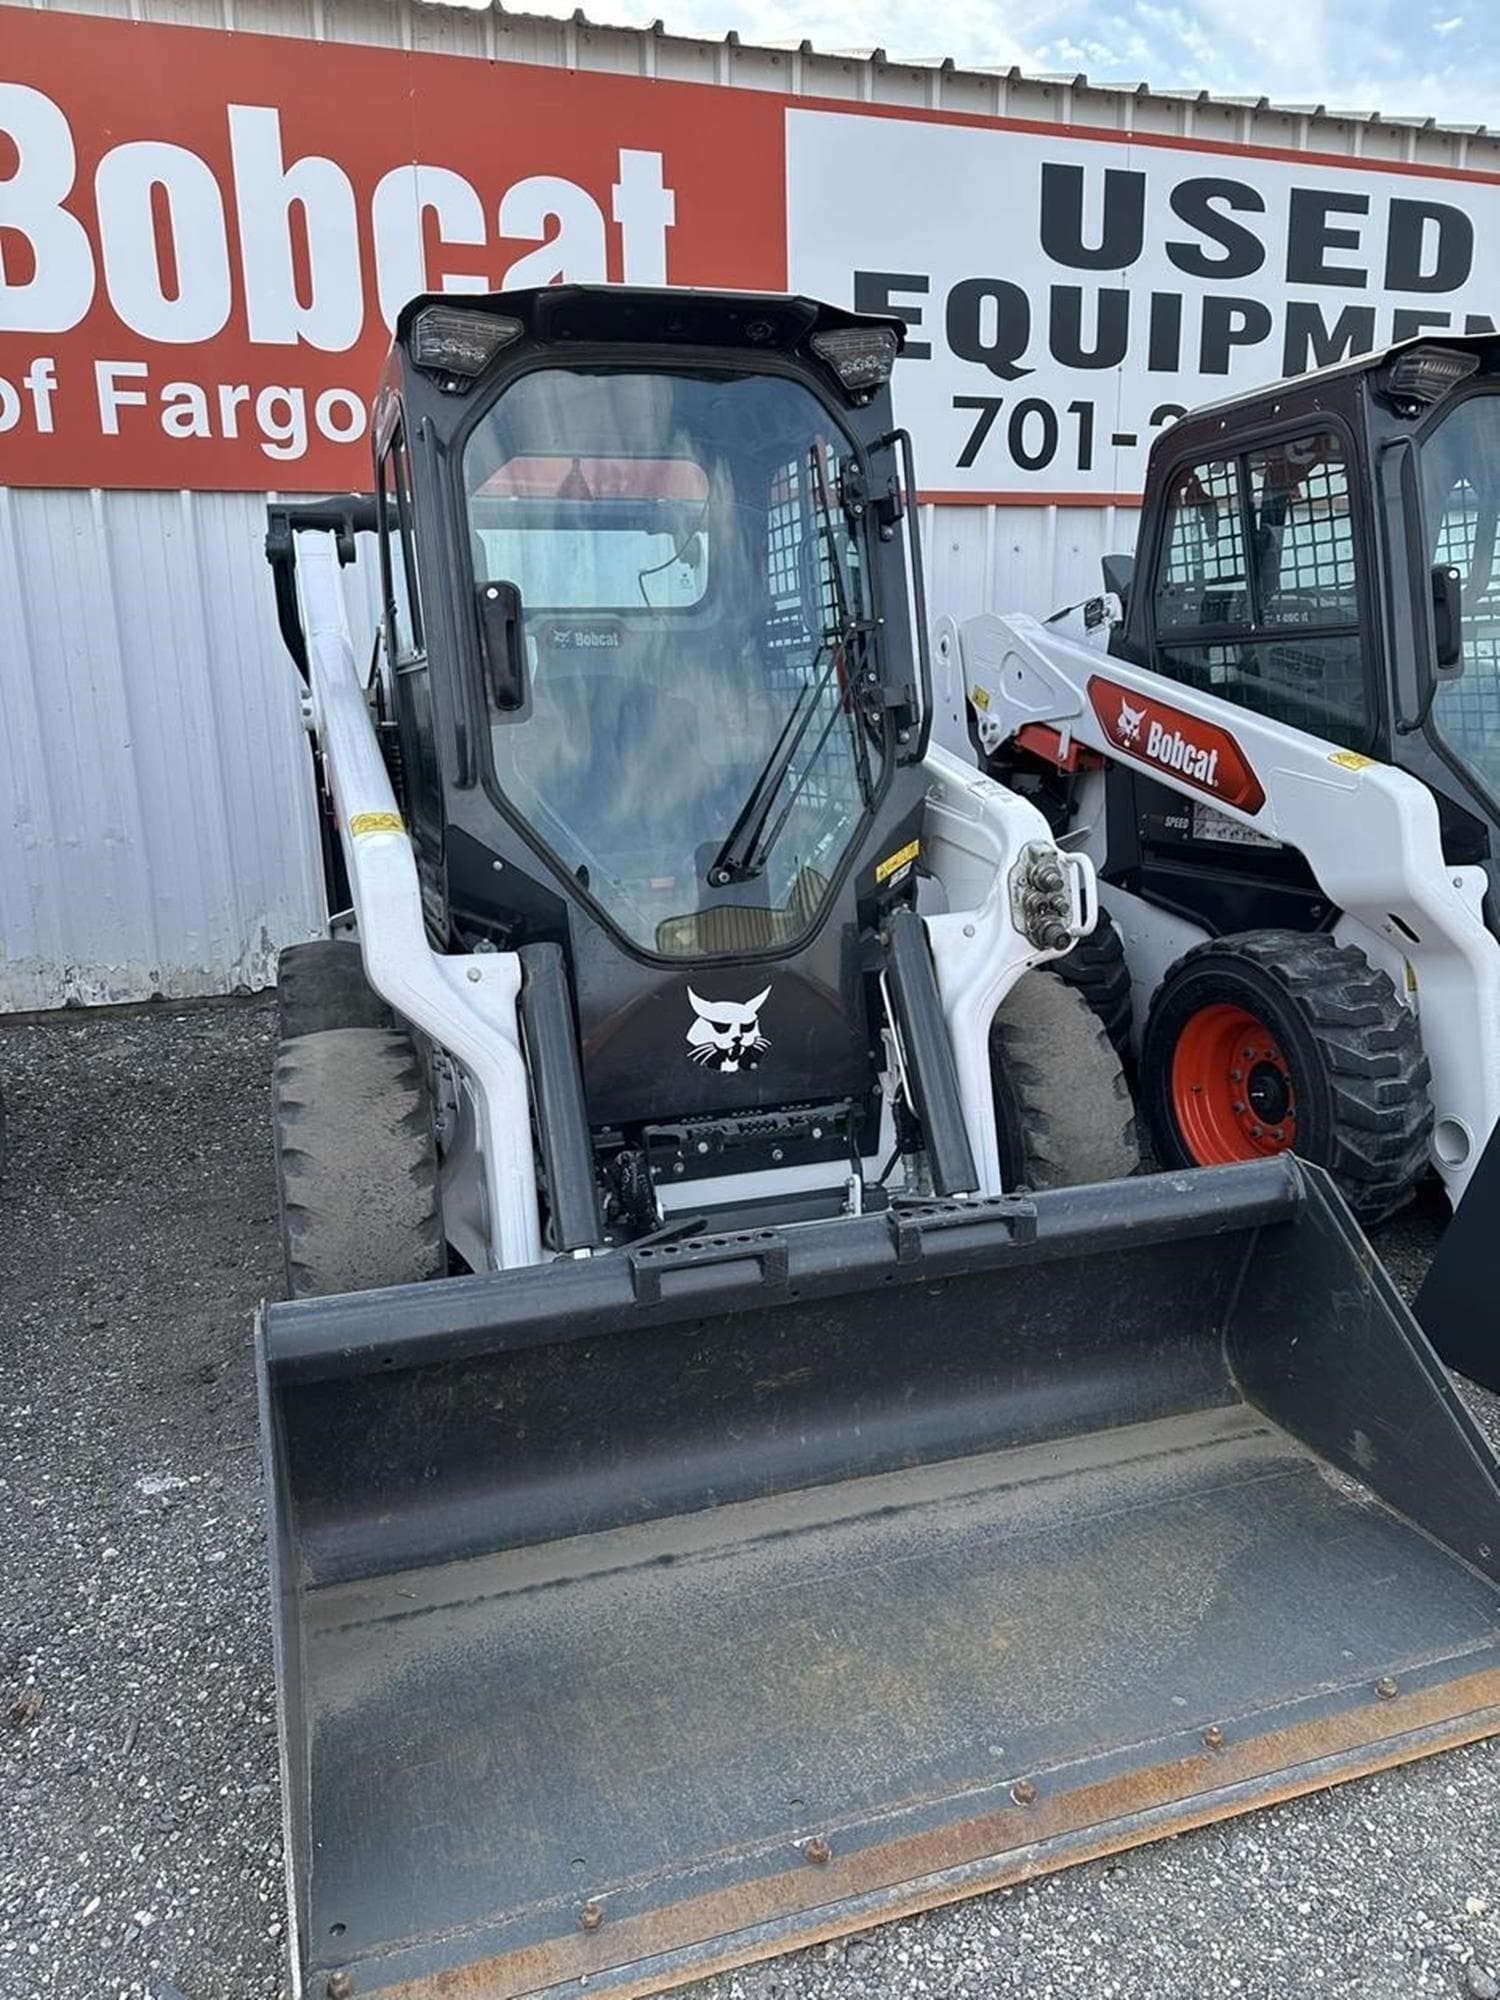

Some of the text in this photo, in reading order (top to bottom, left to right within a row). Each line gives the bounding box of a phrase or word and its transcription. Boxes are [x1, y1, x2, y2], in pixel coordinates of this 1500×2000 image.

[0, 82, 675, 352] Bobcat
[1040, 162, 1474, 293] USED
[854, 271, 1500, 381] EQUIPM
[94, 359, 367, 460] Fargo
[574, 632, 618, 647] Bobcat
[1146, 720, 1218, 787] Bobcat
